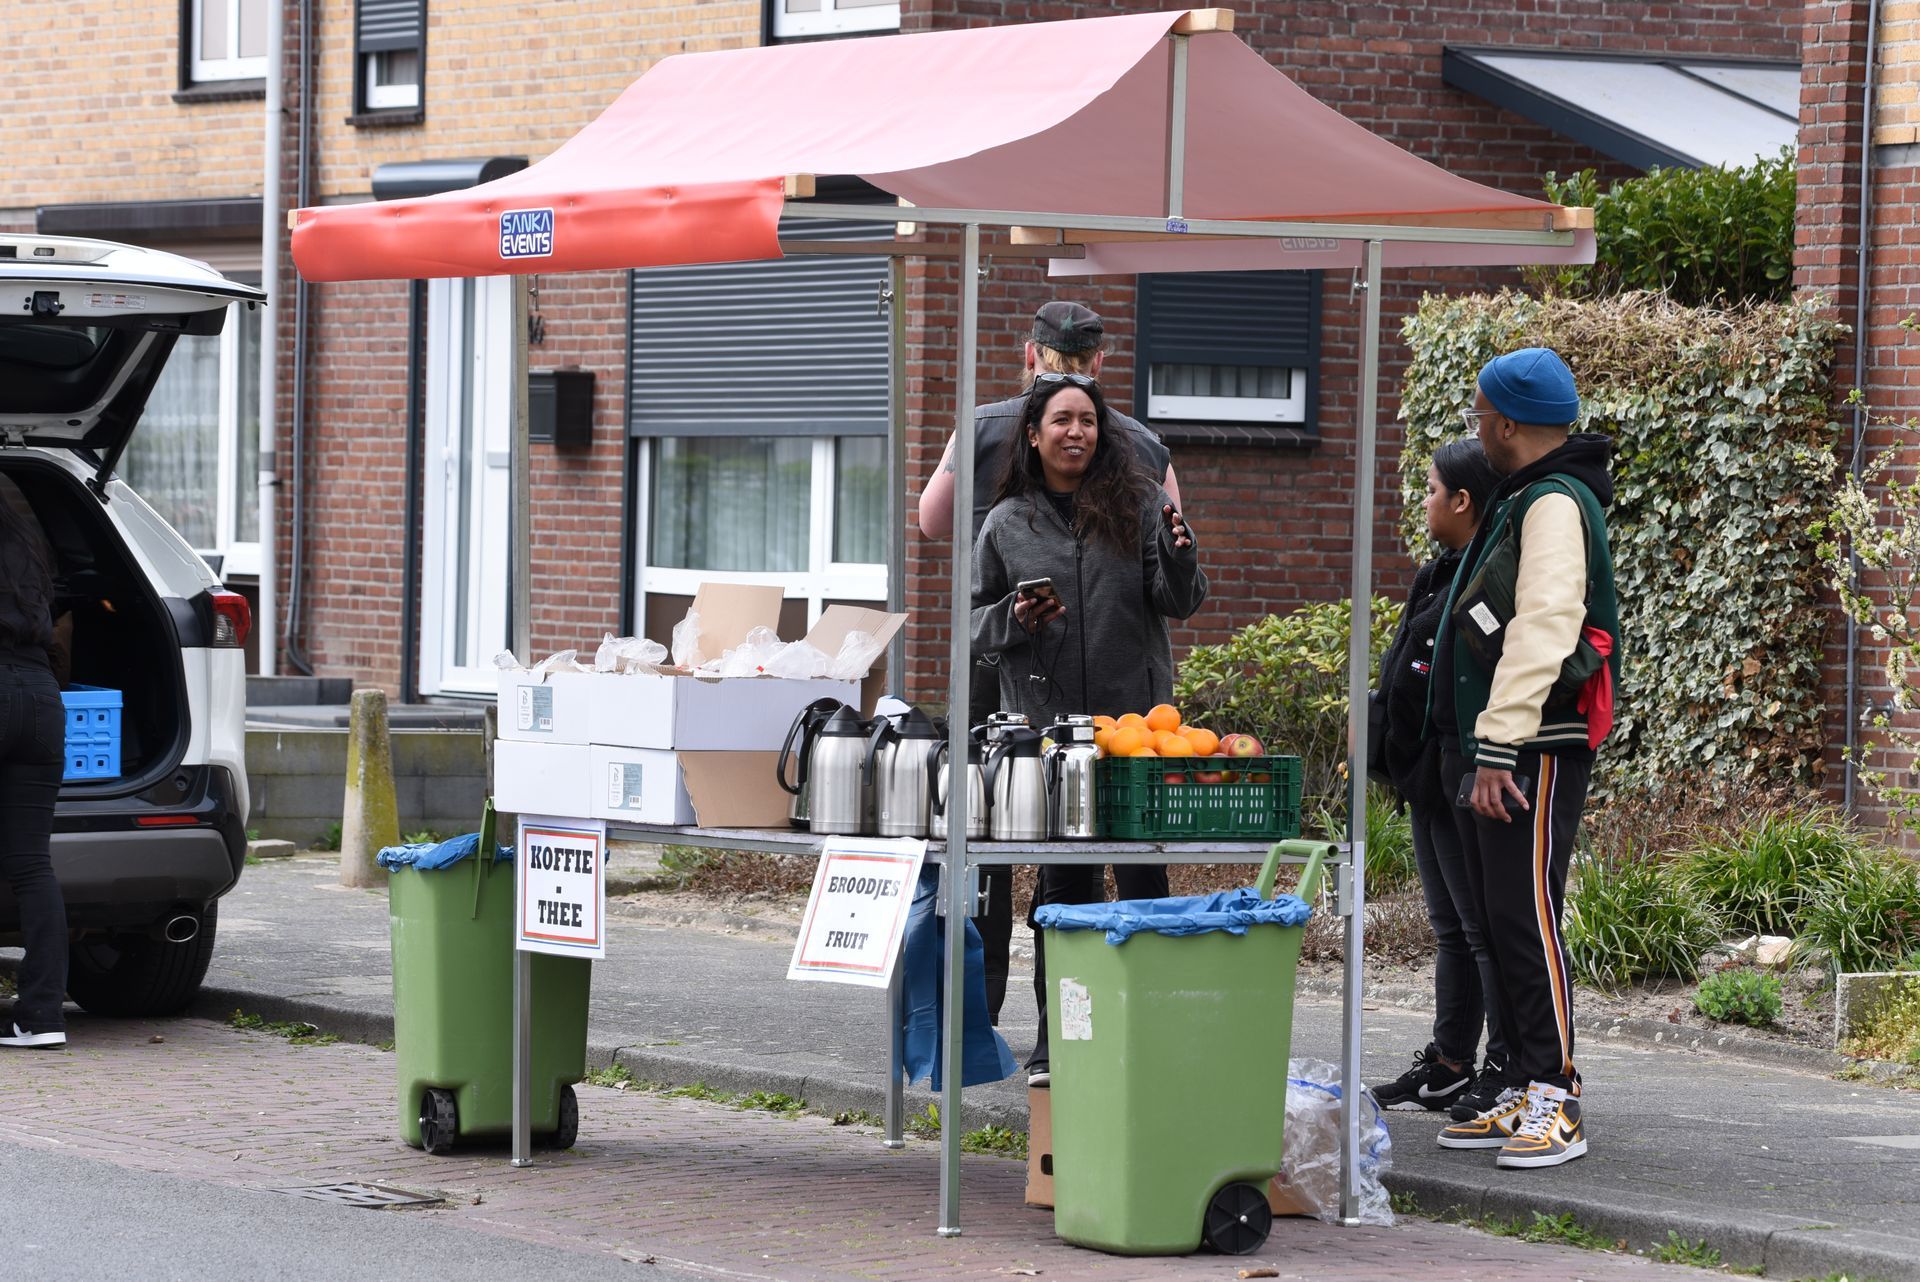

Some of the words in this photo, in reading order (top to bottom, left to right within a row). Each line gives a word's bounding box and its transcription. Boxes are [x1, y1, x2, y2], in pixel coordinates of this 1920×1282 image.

[502, 212, 551, 234] SANKA
[501, 232, 550, 255] EVENTS
[530, 845, 593, 874] KOFFIE
[827, 876, 901, 900] BROODJES
[538, 899, 582, 928] THEE
[825, 930, 869, 950] FRUIT
